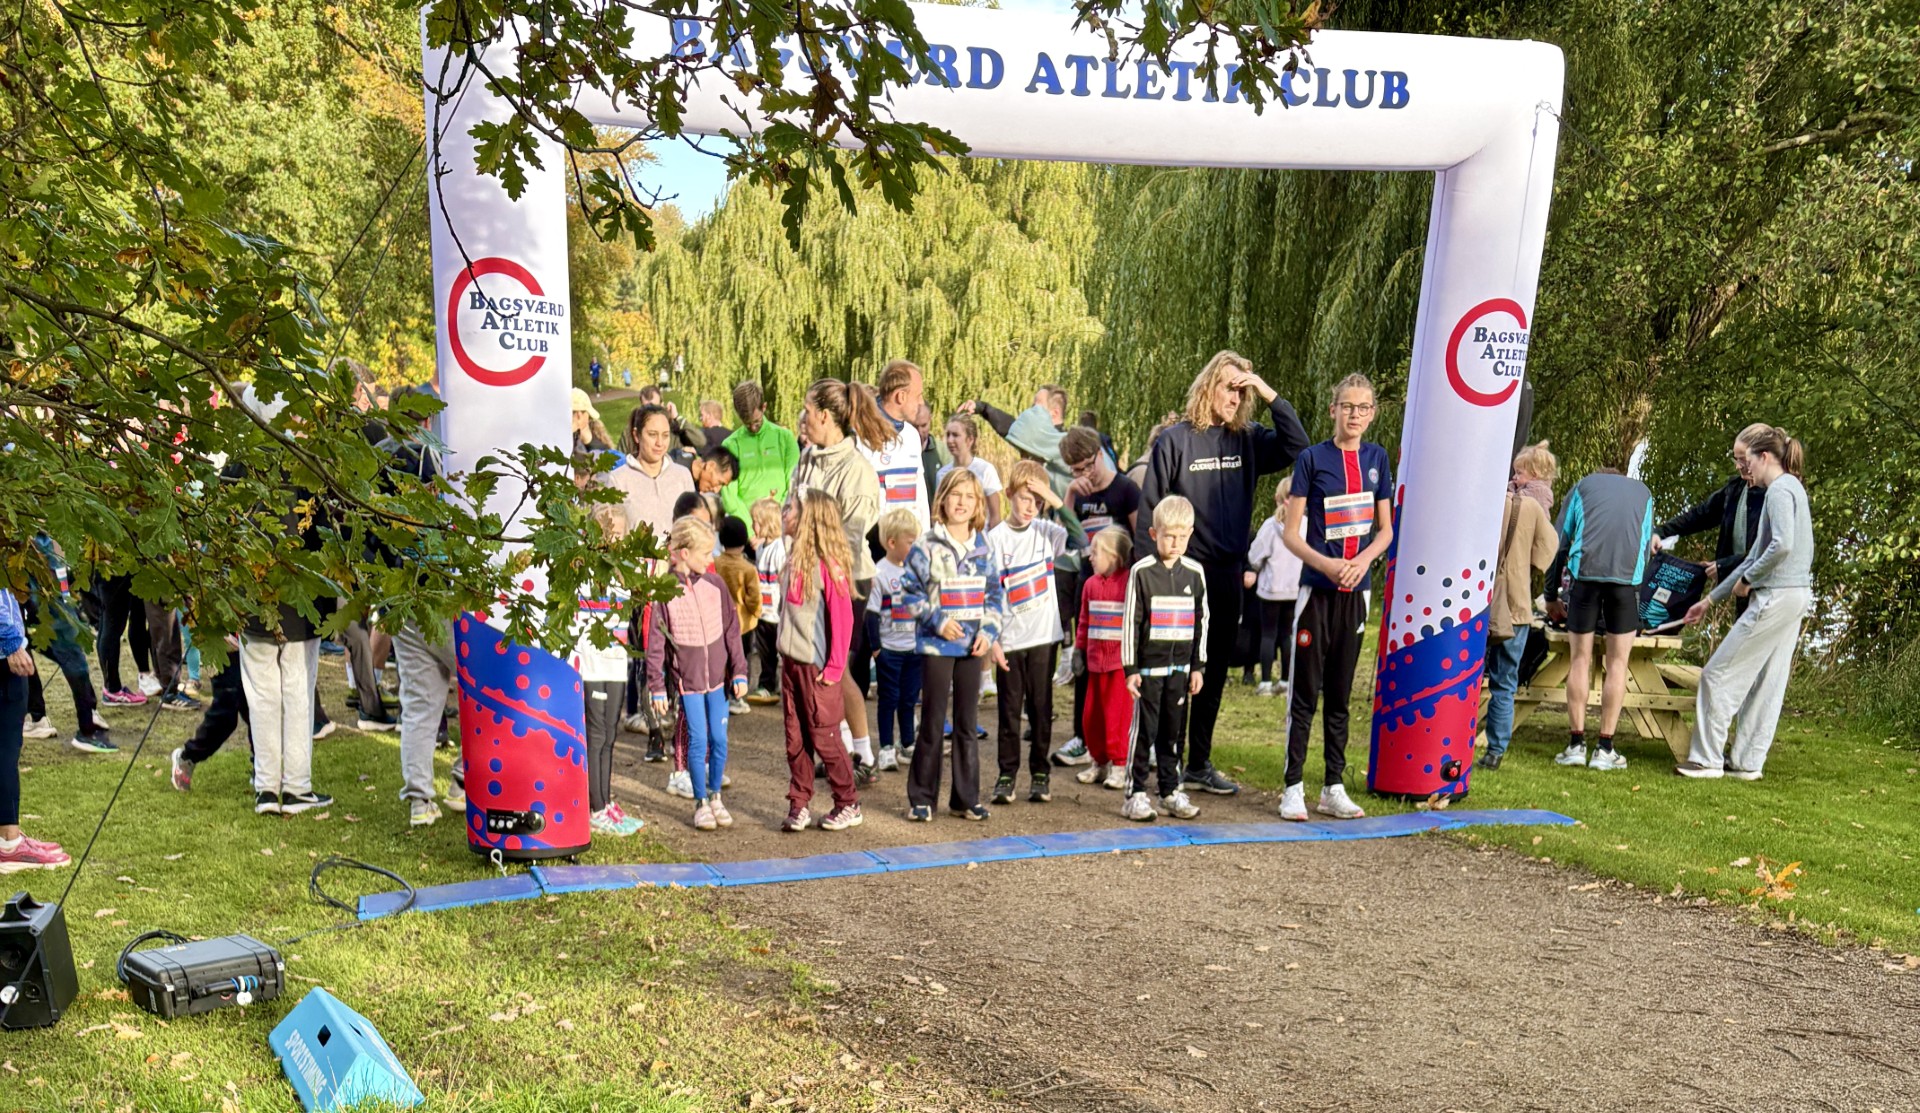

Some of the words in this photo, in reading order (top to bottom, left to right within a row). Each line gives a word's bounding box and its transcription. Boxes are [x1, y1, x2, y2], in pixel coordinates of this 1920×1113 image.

[671, 20, 1005, 90] BARD
[1280, 66, 1410, 110] CLUB
[480, 311, 560, 336] ATLETIK
[498, 331, 549, 353] CLUB
[1480, 343, 1527, 361] ATLETI
[1081, 502, 1108, 515] FILA
[284, 1028, 328, 1096] SPORTSTIMING
